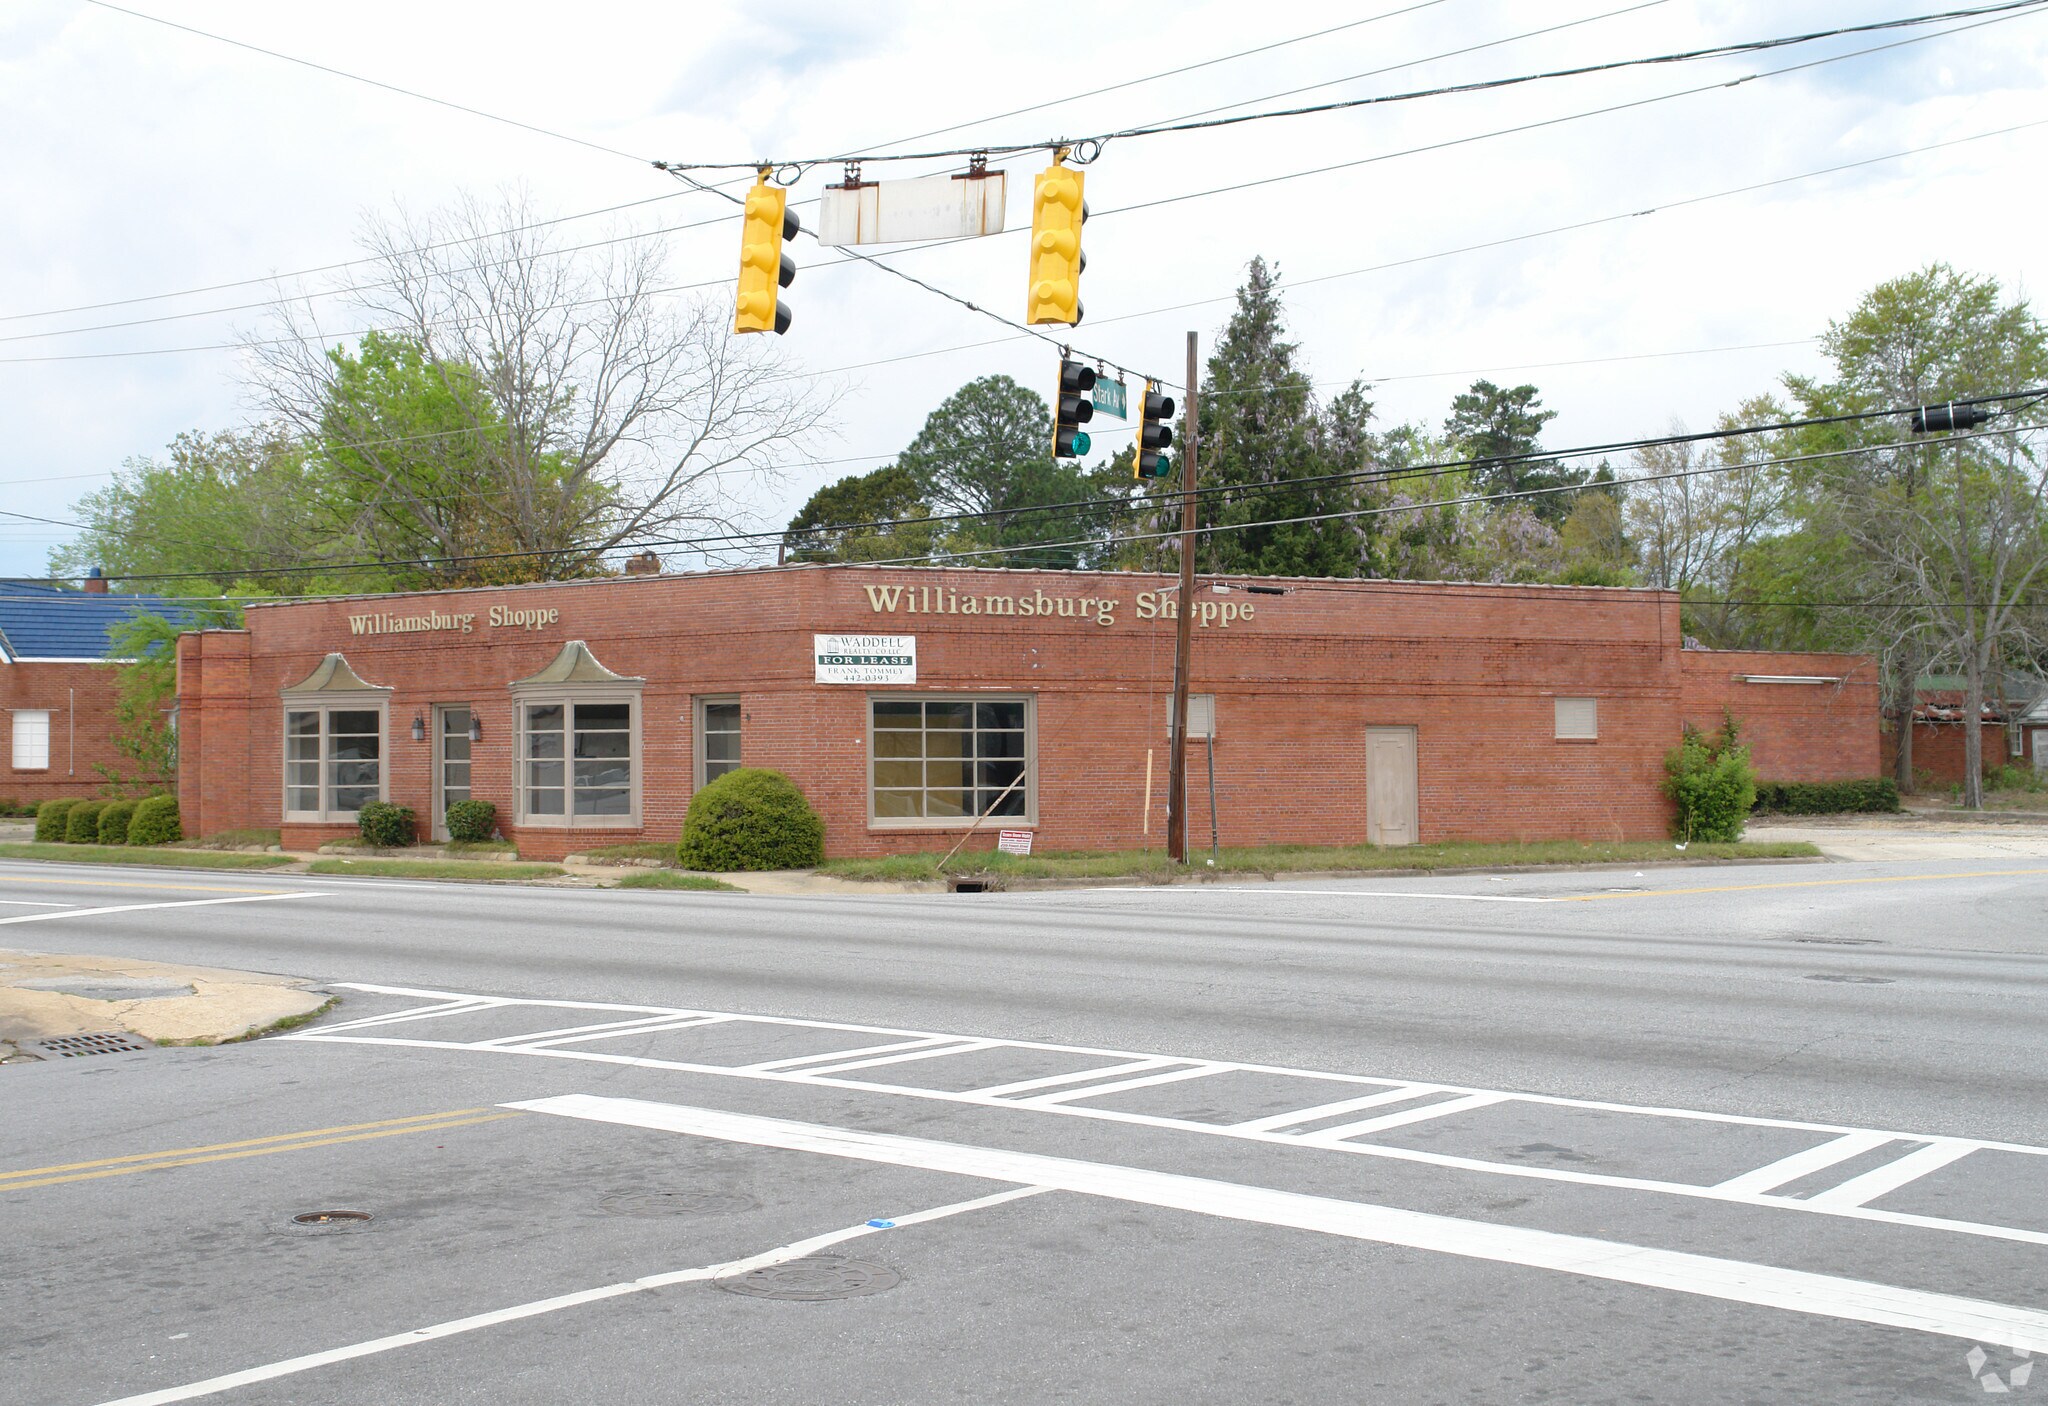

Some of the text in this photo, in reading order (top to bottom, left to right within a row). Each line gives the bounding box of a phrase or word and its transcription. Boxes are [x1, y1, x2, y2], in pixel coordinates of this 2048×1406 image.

[1094, 382, 1111, 405] Stark
[863, 584, 1120, 626] Williamsburg
[348, 604, 559, 633] Williamsburg Shoppe
[841, 637, 904, 647] WADDELL
